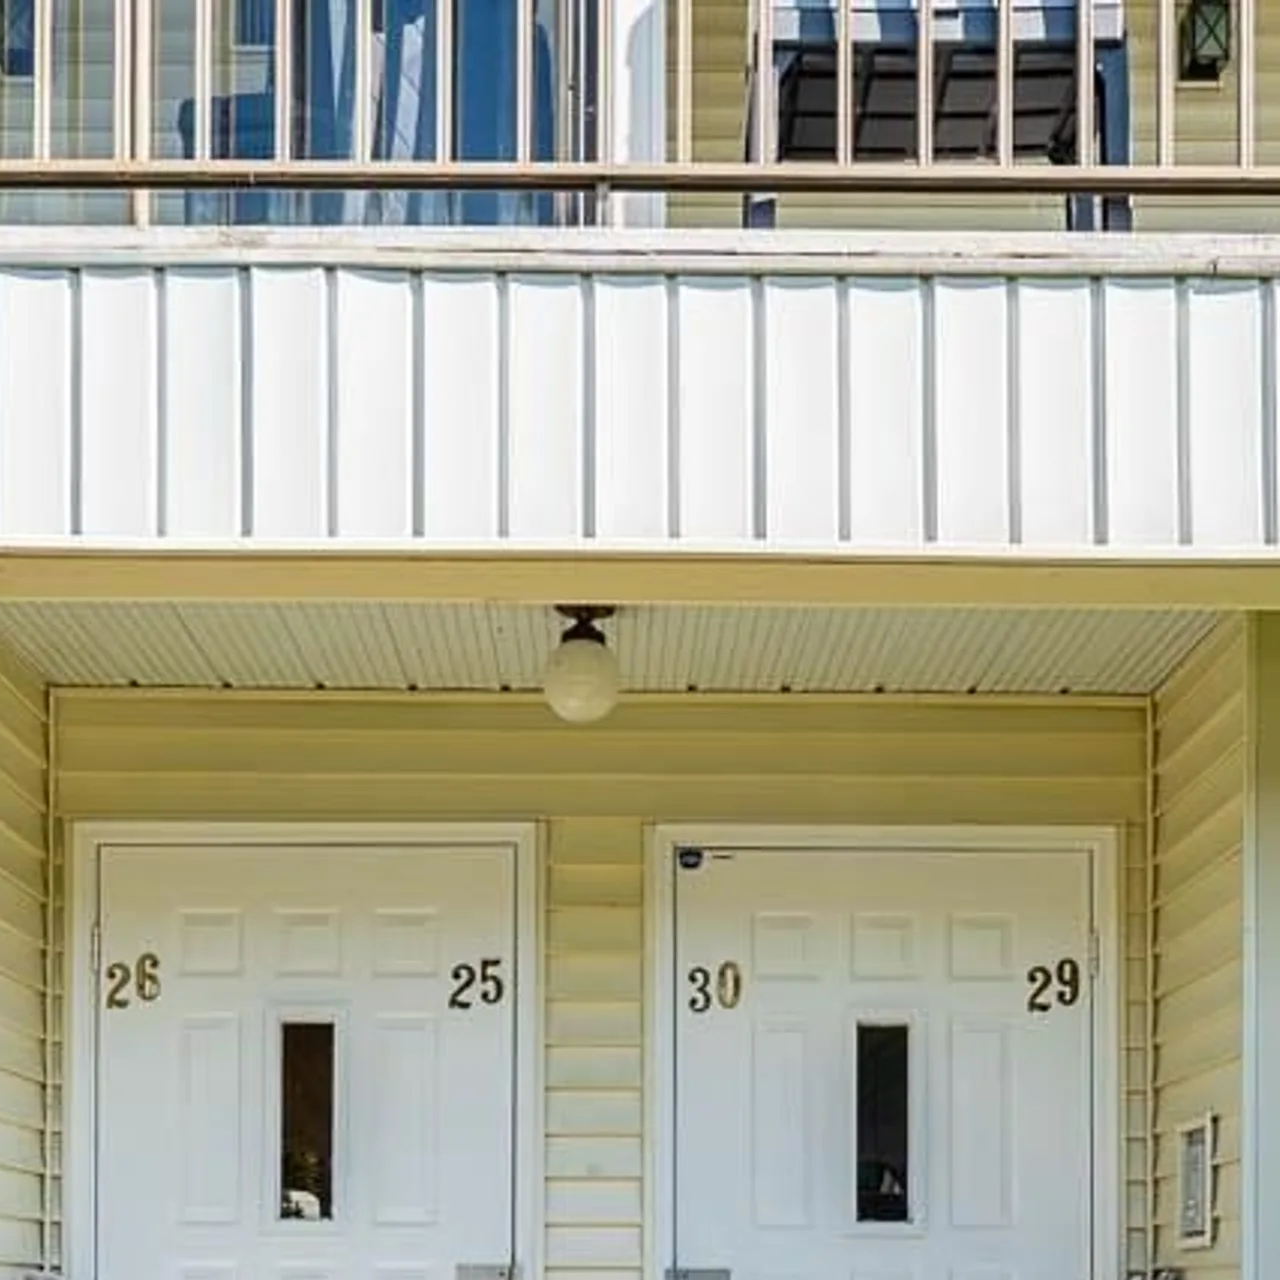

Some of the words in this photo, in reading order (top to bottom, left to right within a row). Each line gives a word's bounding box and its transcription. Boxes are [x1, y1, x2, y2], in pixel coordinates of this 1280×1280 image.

[106, 952, 162, 1010] 26
[448, 958, 504, 1010] 25
[688, 960, 741, 1013] 30
[1027, 957, 1080, 1013] 29
